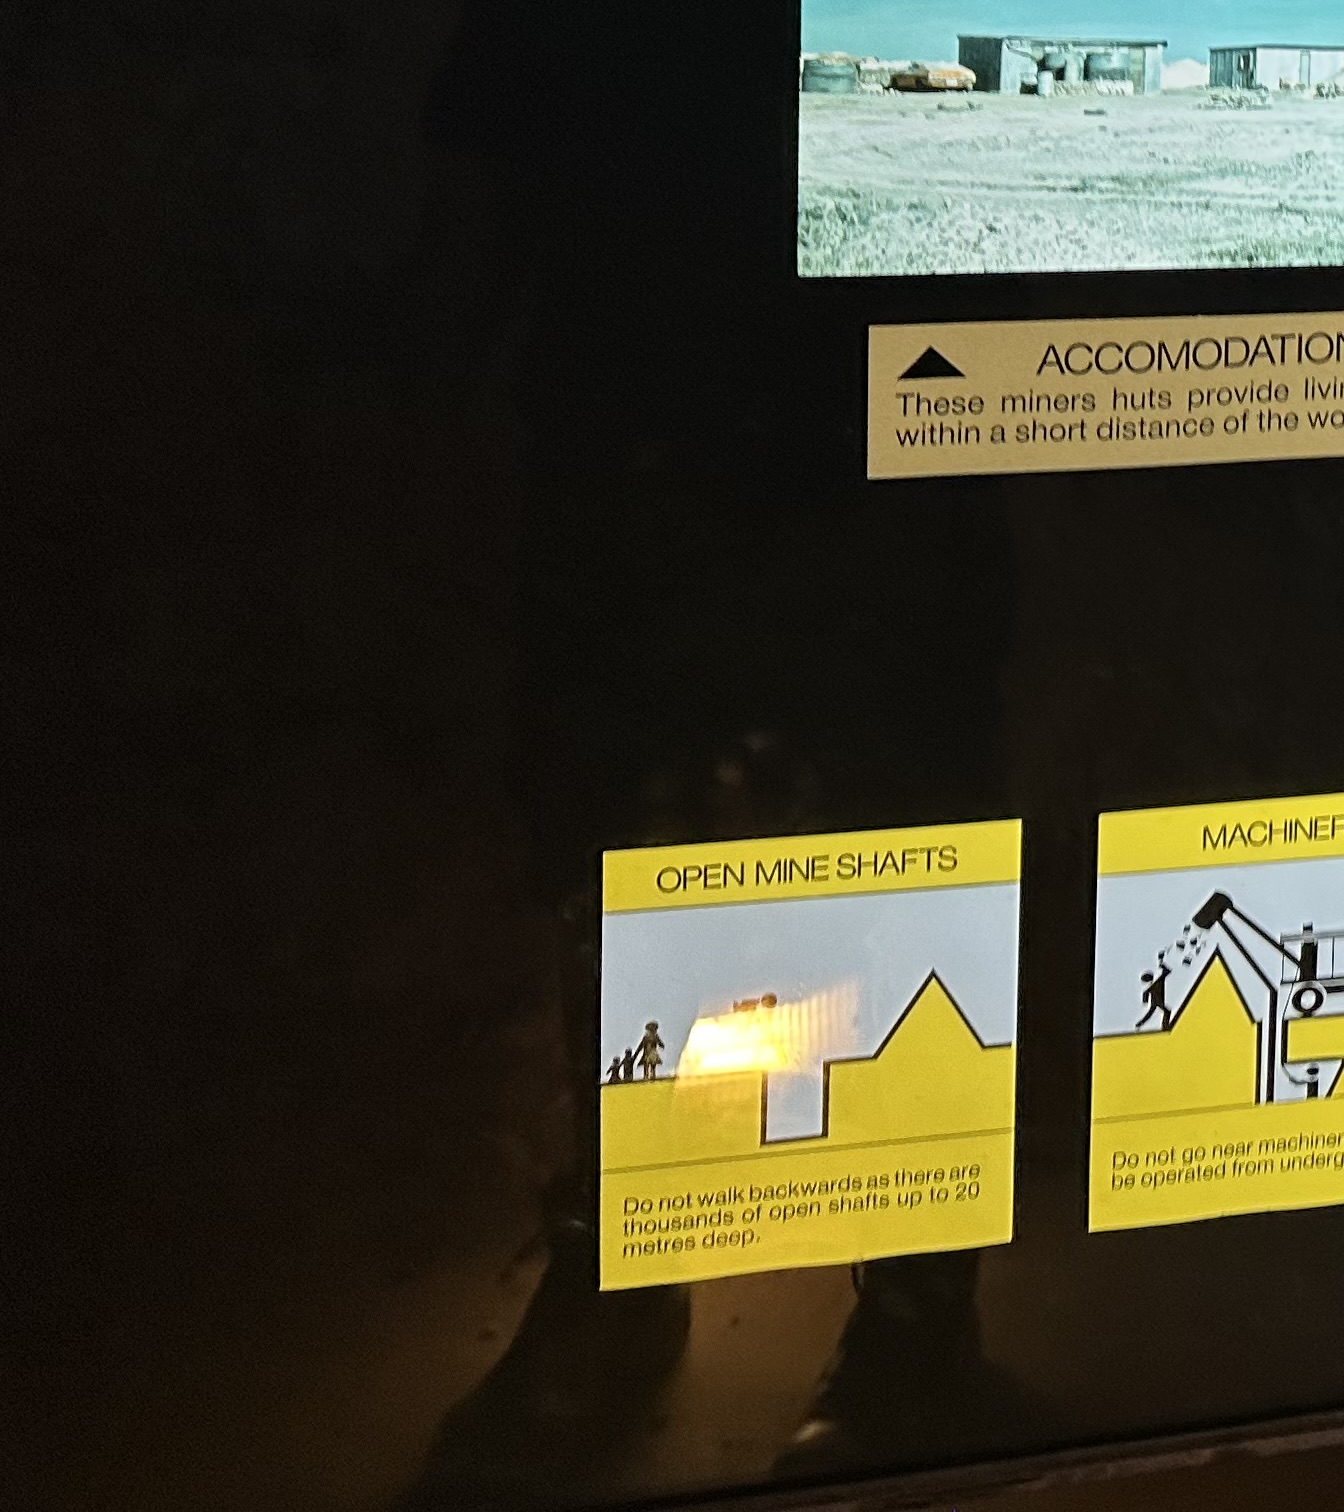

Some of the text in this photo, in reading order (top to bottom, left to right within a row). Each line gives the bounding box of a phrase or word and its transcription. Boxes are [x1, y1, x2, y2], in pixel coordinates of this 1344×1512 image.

[895, 392, 985, 417] These
[1001, 388, 1096, 413] miners
[1112, 383, 1172, 409] huts
[1187, 379, 1289, 412] provide
[895, 421, 981, 447] within
[989, 424, 1006, 443] a
[1015, 416, 1087, 442] short
[1096, 413, 1215, 439] distance
[1223, 409, 1250, 434] of
[1257, 408, 1299, 433] the
[656, 844, 958, 892] OPEN MINE SHAFTS
[1112, 1150, 1140, 1169] Do
[1145, 1145, 1176, 1166] not
[1181, 1147, 1206, 1168] go
[1211, 1142, 1254, 1160] near
[623, 1164, 981, 1215] Do not walk backwards as there are
